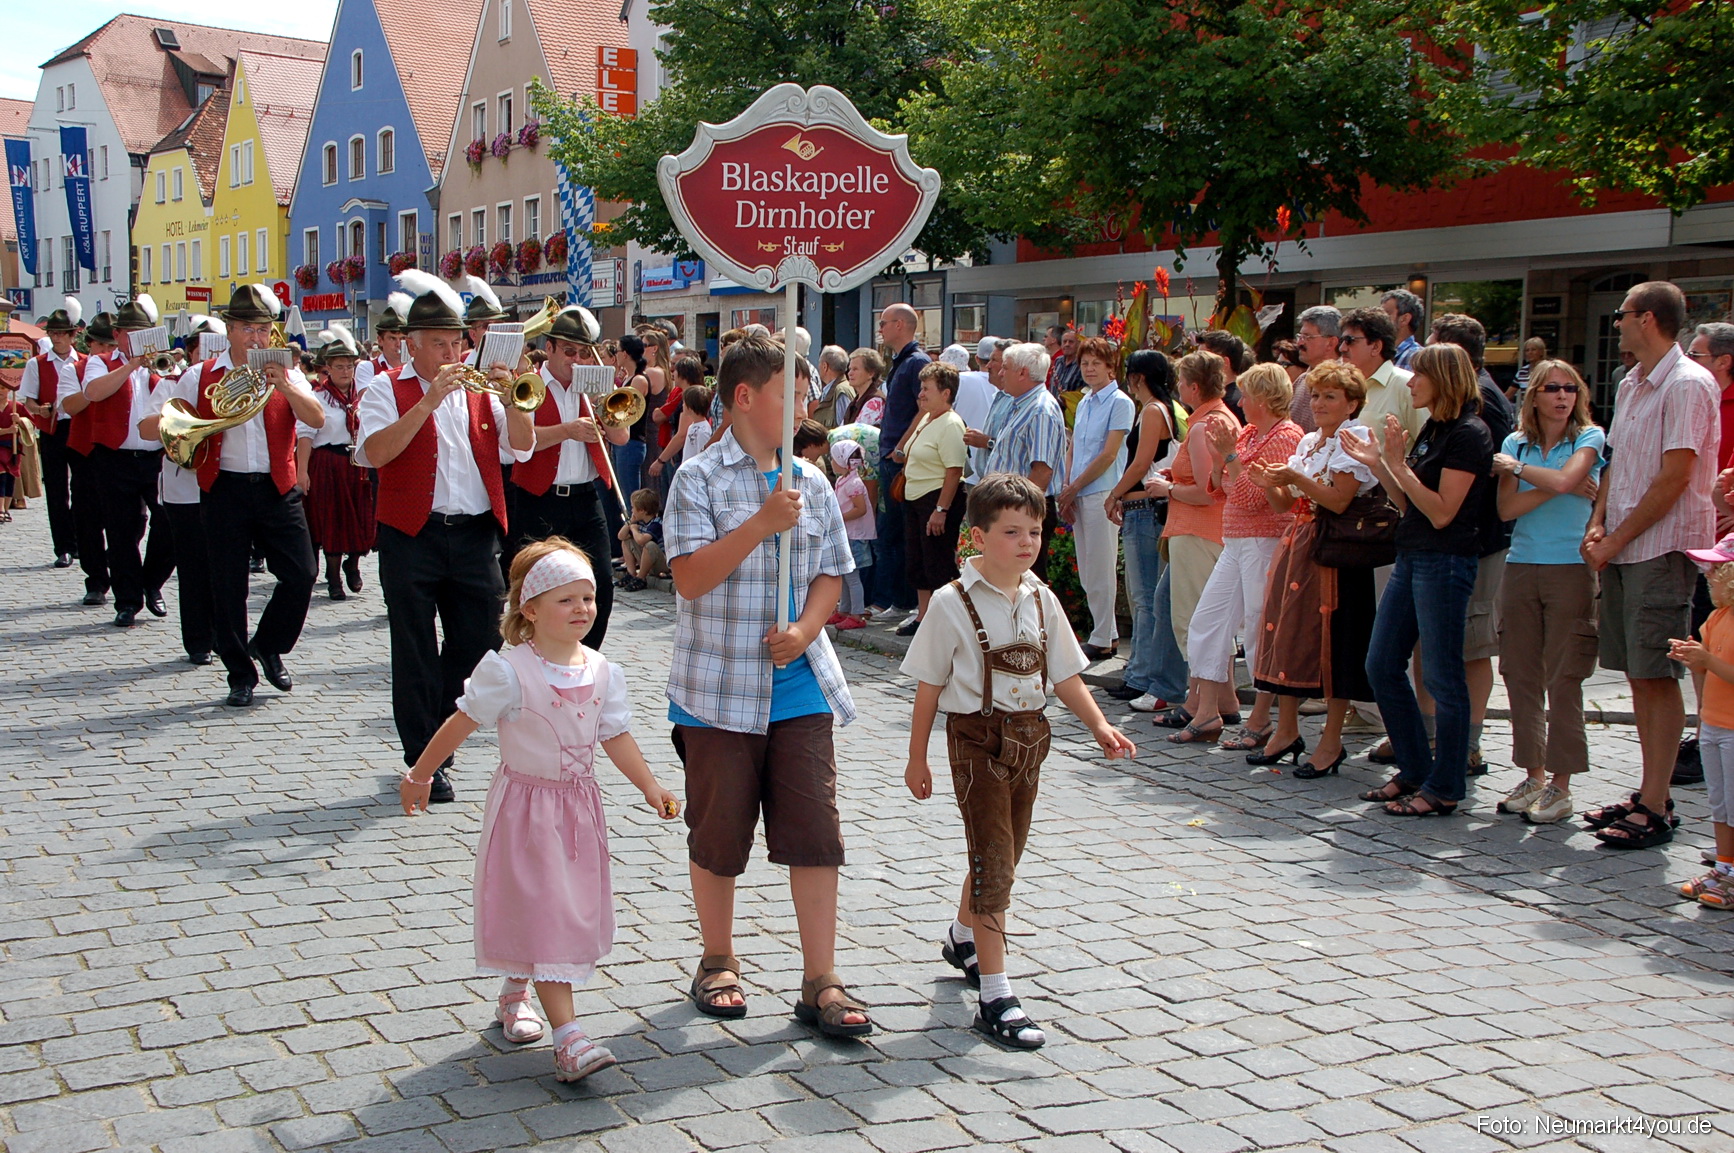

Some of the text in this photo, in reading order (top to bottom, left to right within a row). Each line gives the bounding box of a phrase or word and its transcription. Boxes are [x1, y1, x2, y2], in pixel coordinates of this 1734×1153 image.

[721, 161, 889, 200] Blaskapelle
[76, 181, 89, 232] RUPPERT
[735, 200, 876, 230] Dirnhofer
[165, 220, 184, 238] HOTEL
[783, 235, 821, 256] Stauf
[165, 299, 191, 311] Restaurant
